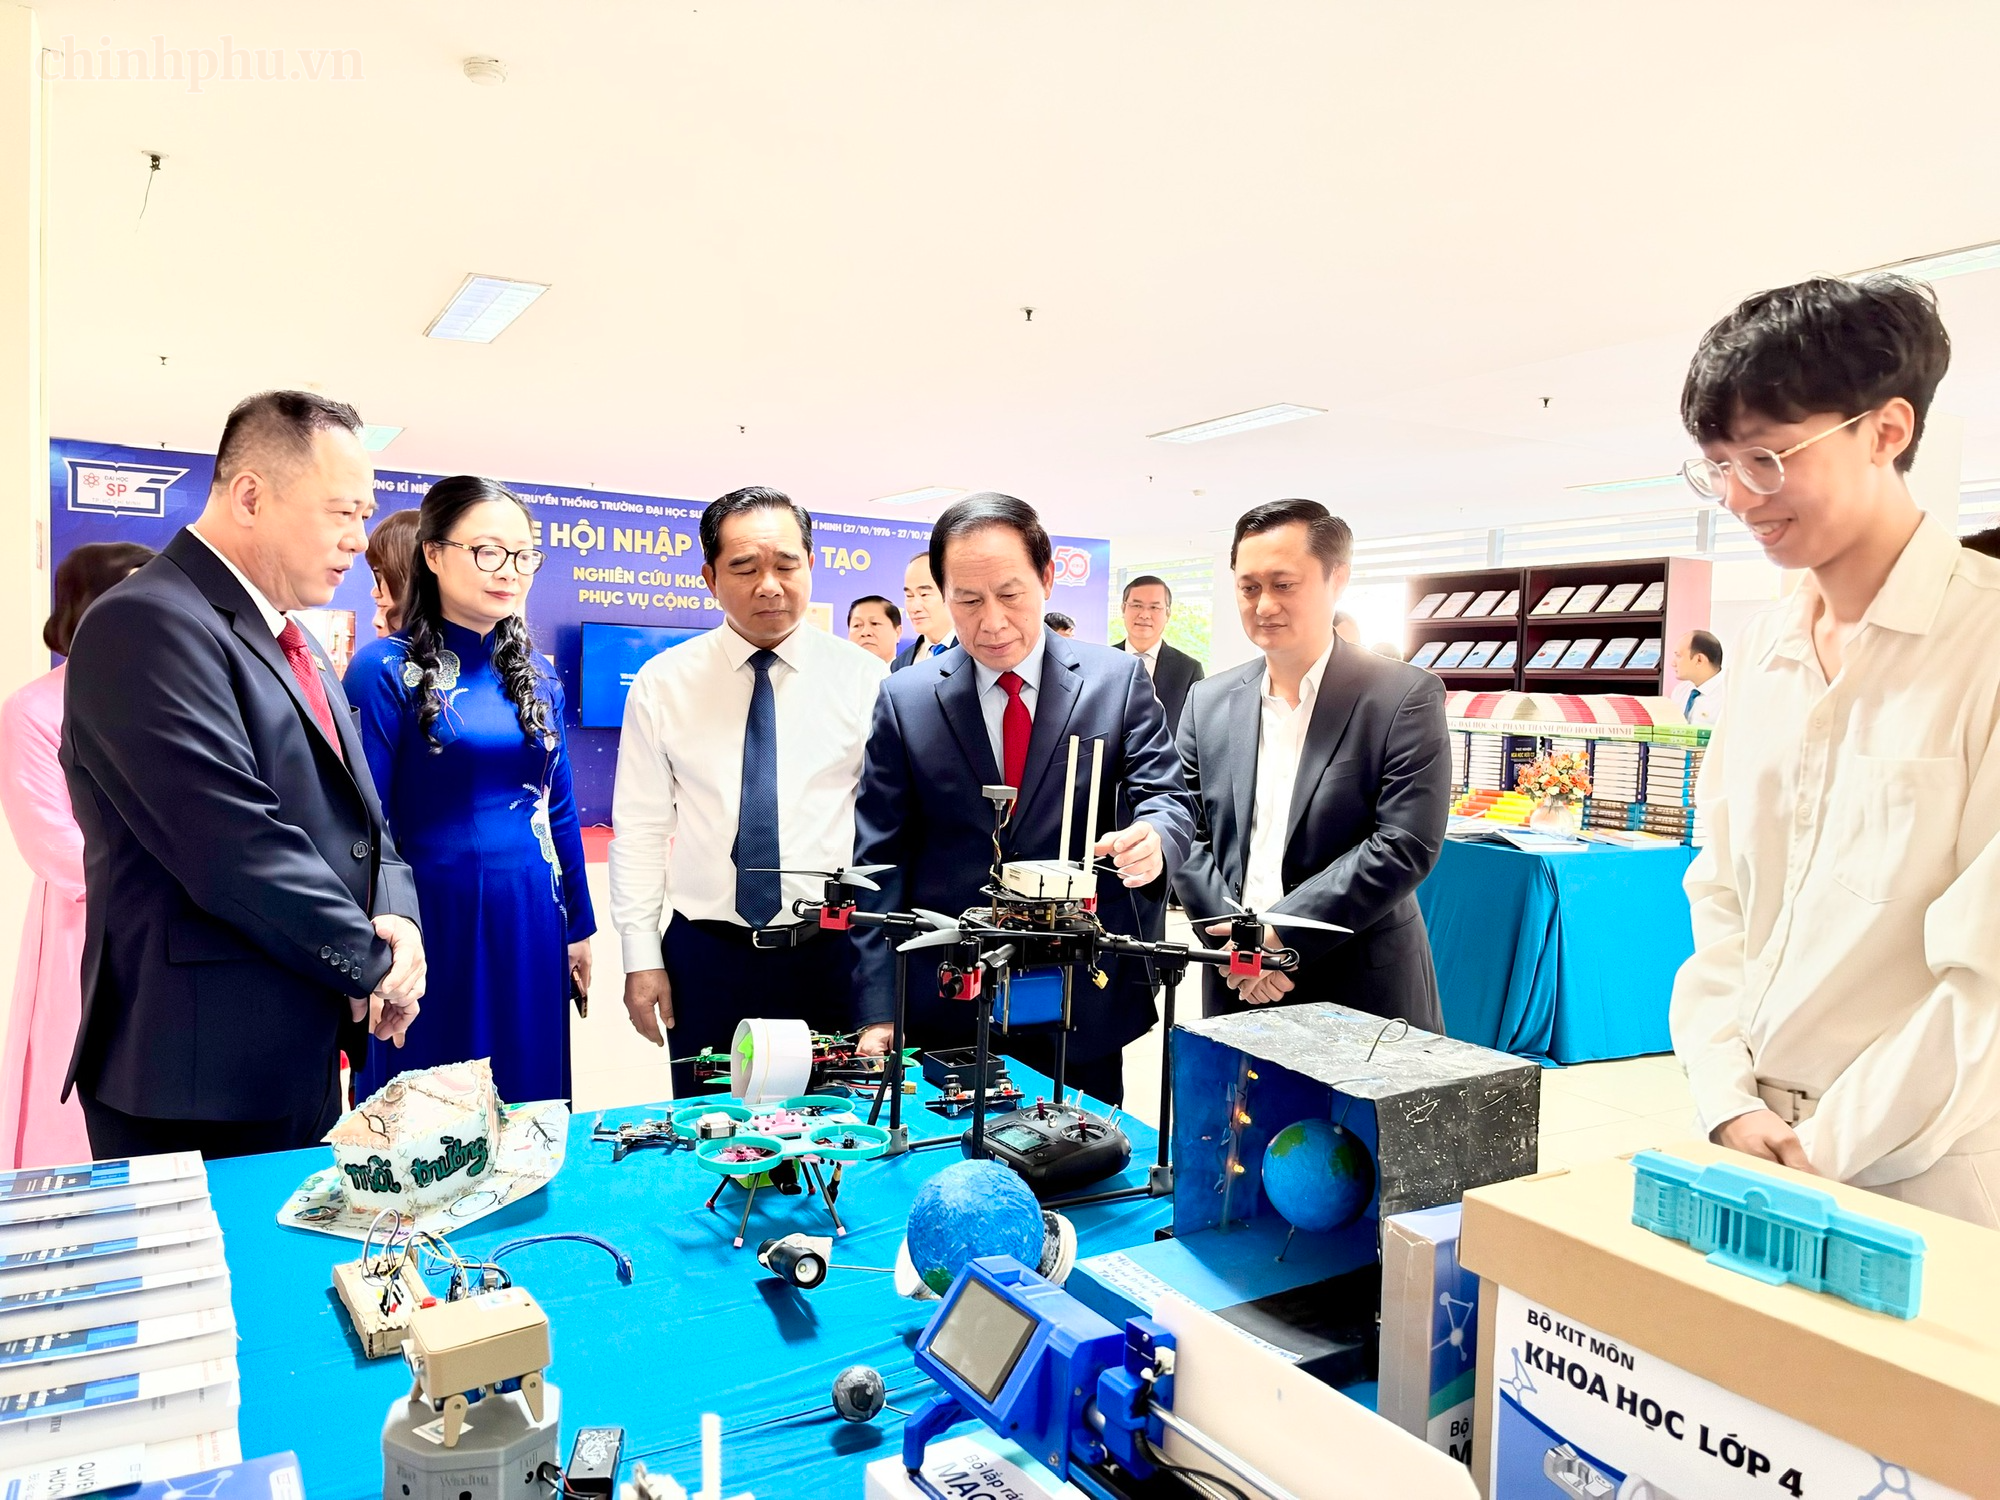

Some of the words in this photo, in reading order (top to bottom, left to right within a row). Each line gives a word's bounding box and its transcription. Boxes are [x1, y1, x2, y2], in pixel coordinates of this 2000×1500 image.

[106, 483, 127, 497] SP
[561, 495, 599, 510] THỐNG
[601, 499, 644, 514] TRƯỜNG
[645, 505, 664, 517] ĐẠI
[665, 507, 688, 519] HỌC
[819, 521, 842, 532] MINH
[843, 523, 891, 537] (27/10/1976
[897, 529, 932, 541] 27/10/2
[550, 519, 605, 557] HỘI
[613, 526, 692, 563] NHẬP
[821, 546, 871, 576] TẠO
[1054, 548, 1088, 578] 50
[573, 566, 635, 585] NGHIÊN
[638, 569, 672, 587] CỨU
[675, 575, 708, 590] KHO
[579, 589, 624, 608] PHỤC
[627, 593, 650, 610] VỤ
[652, 592, 700, 612] CỘNG
[1527, 1308, 1552, 1333] BỘ
[1555, 1321, 1586, 1347] KIT
[1589, 1337, 1635, 1371] MÔN
[1525, 1340, 1609, 1403] KHOA
[1616, 1383, 1684, 1441] HỌC
[1699, 1424, 1771, 1478] LỚP
[1778, 1467, 1803, 1498] 4
[964, 1454, 988, 1470] Bộ
[980, 1469, 1004, 1489] lắp
[1001, 1488, 1024, 1500] rá
